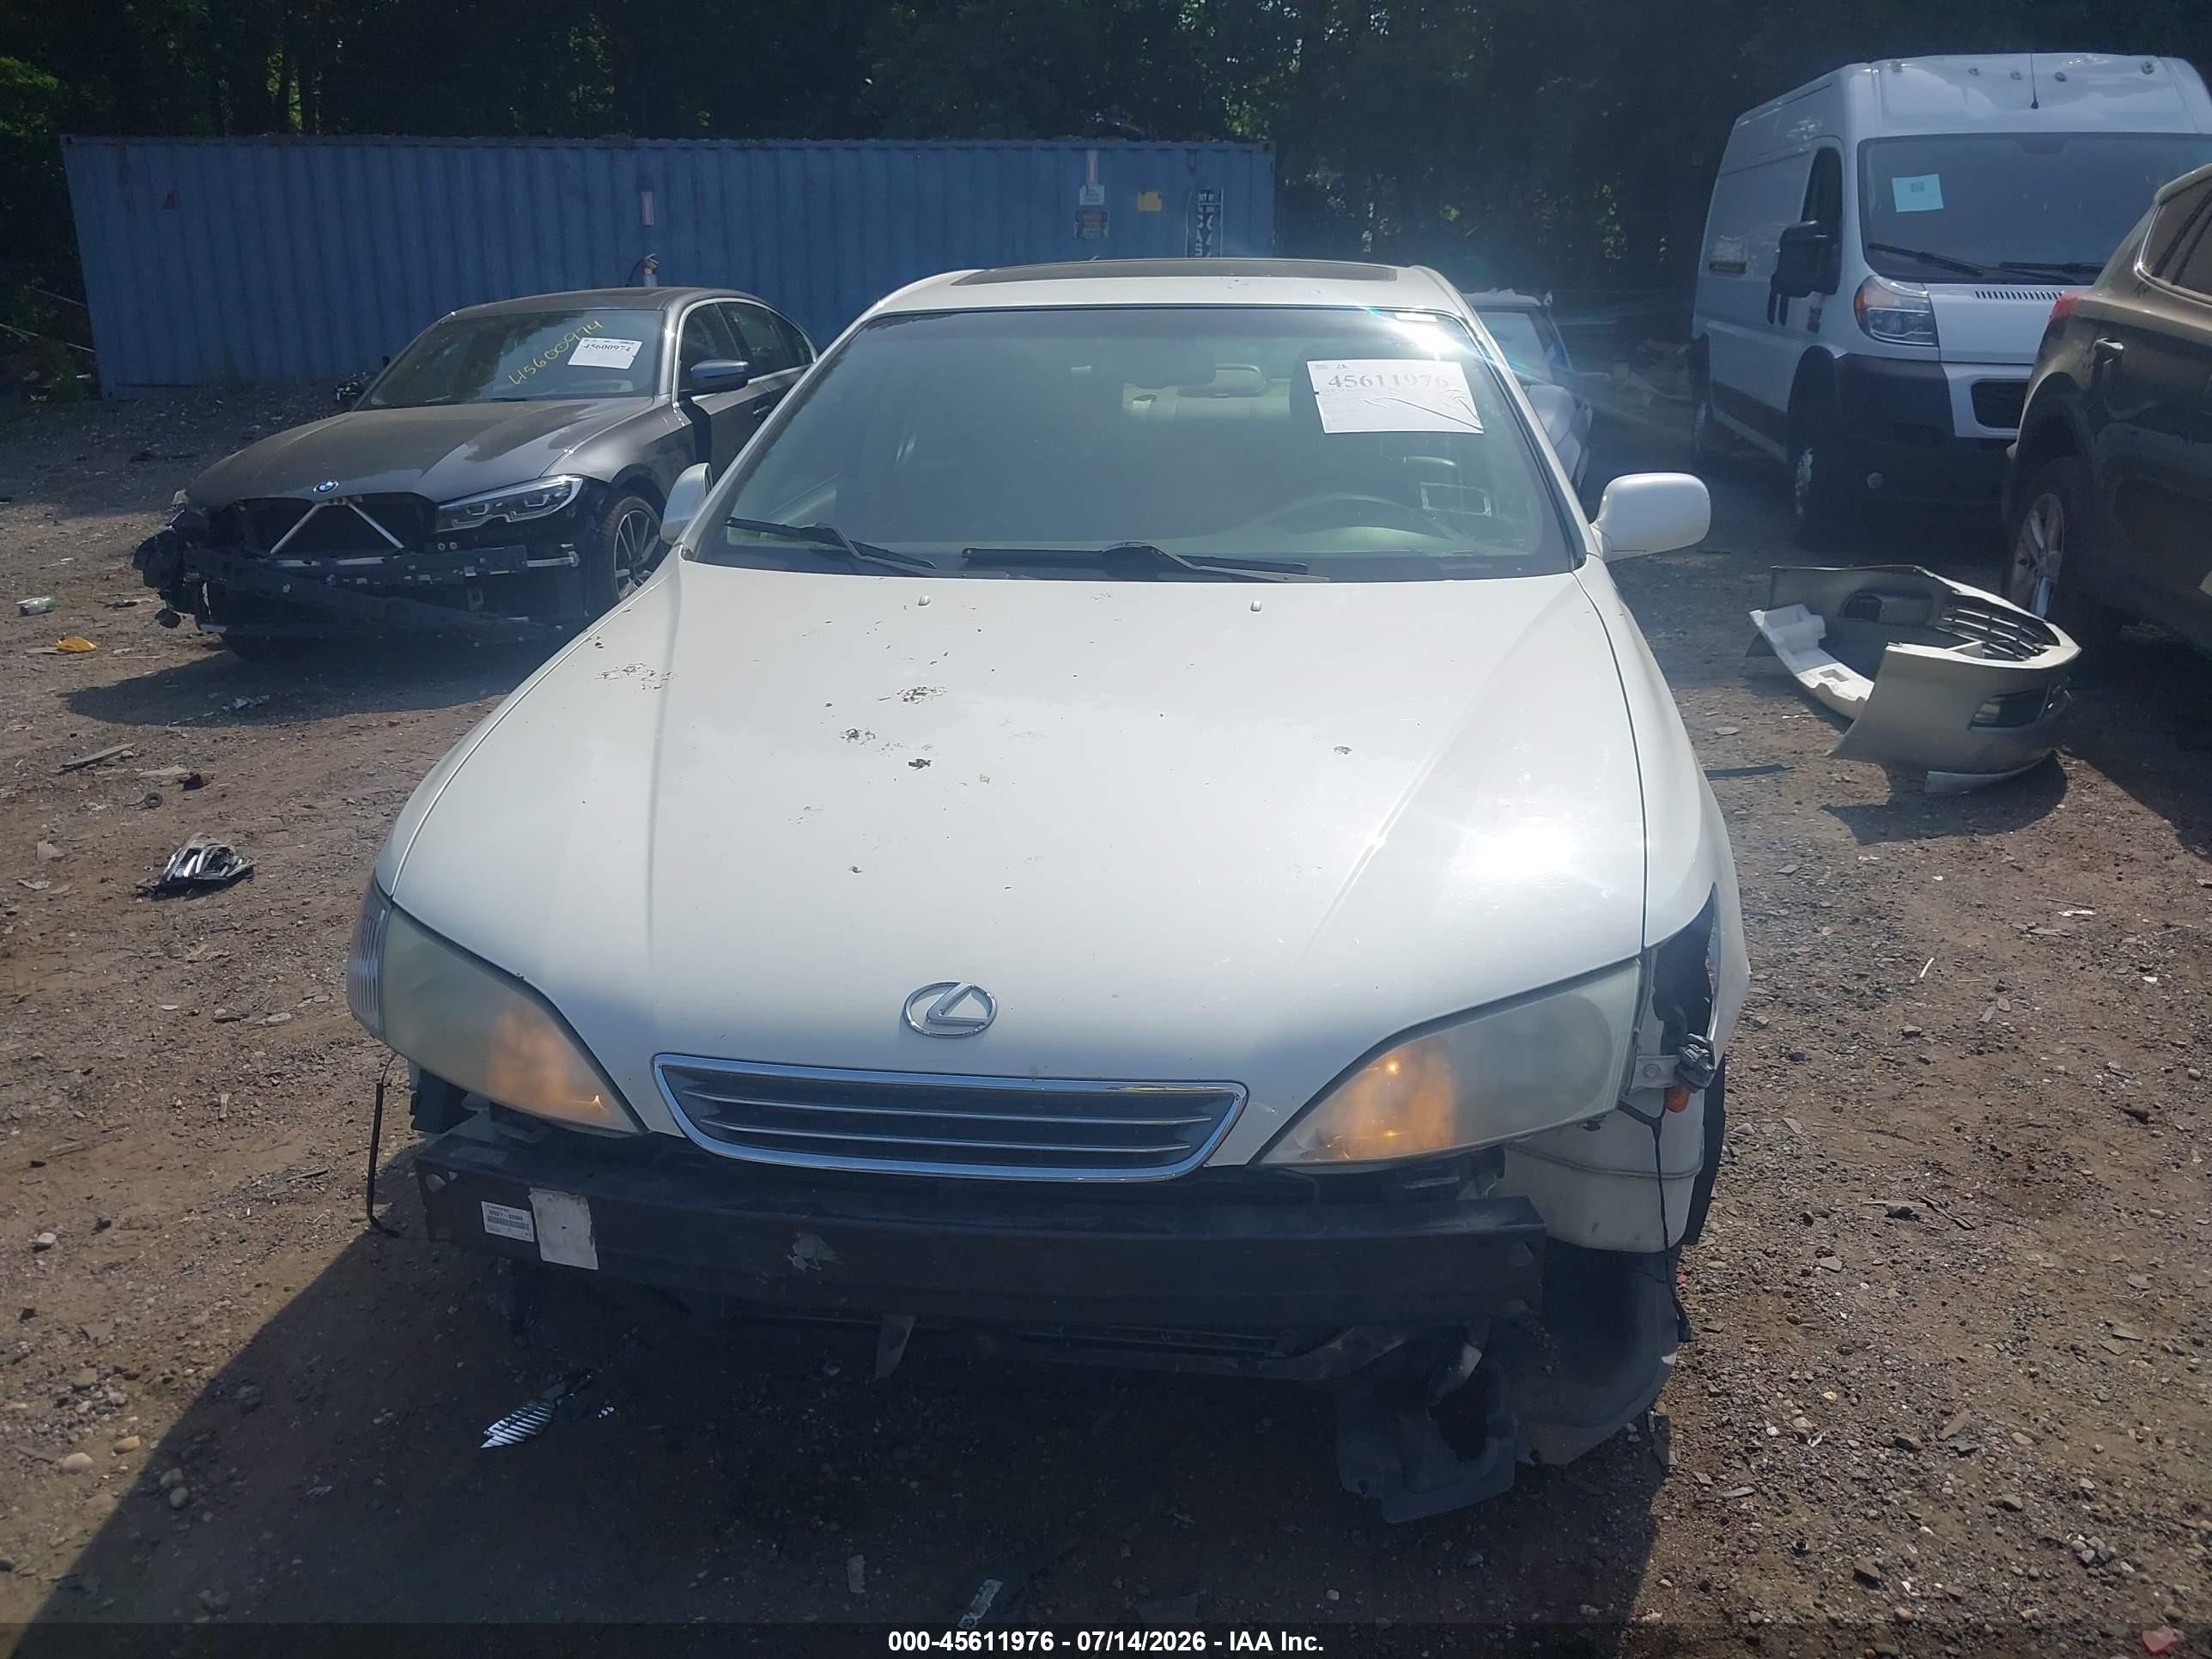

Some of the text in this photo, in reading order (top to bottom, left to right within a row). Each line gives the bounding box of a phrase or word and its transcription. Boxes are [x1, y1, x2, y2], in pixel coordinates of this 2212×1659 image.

[508, 319, 603, 386] 45600974
[583, 343, 631, 352] 45600974
[1328, 374, 1449, 389] 45611976
